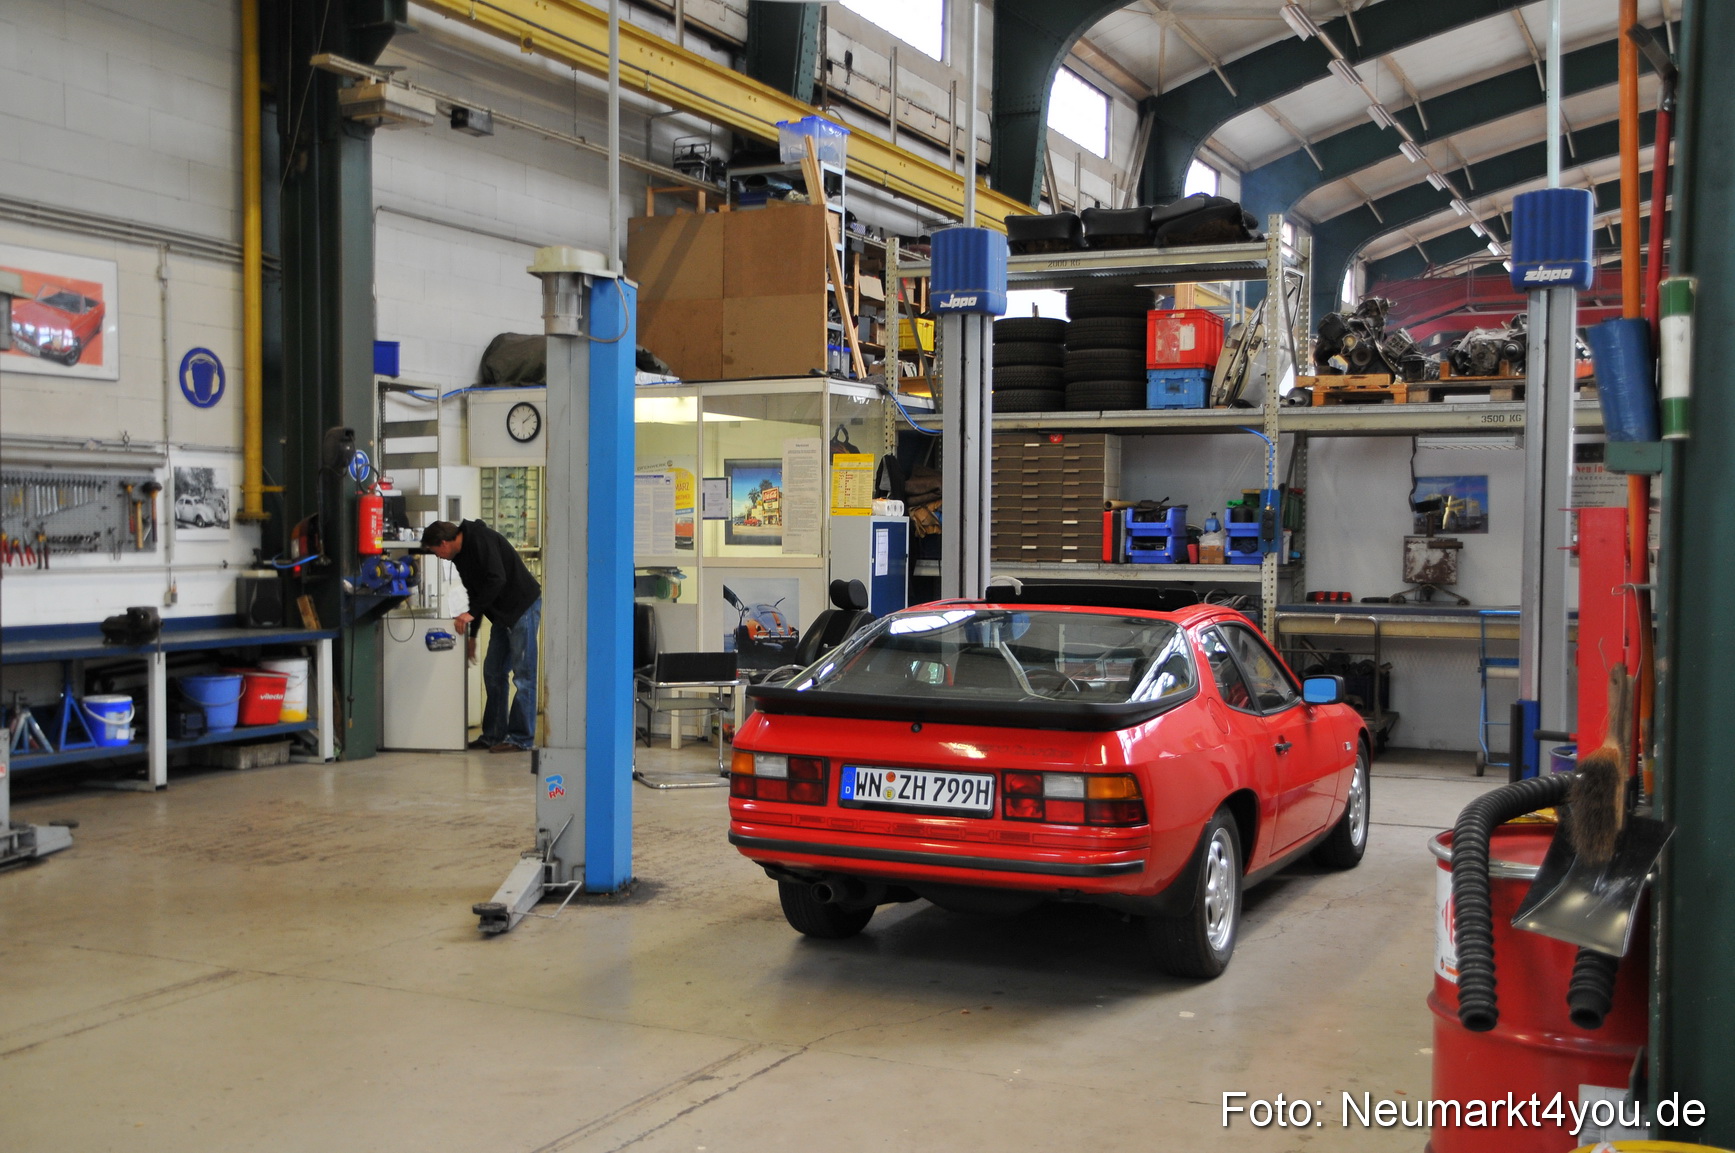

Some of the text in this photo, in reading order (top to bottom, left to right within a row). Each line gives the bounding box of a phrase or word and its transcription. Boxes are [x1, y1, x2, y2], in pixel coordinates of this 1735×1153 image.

[1047, 259, 1081, 268] 2000 KG
[1523, 265, 1573, 282] zippo
[1481, 414, 1522, 423] 3500 KG
[845, 786, 851, 794] D
[856, 771, 990, 806] WN ZH 799H
